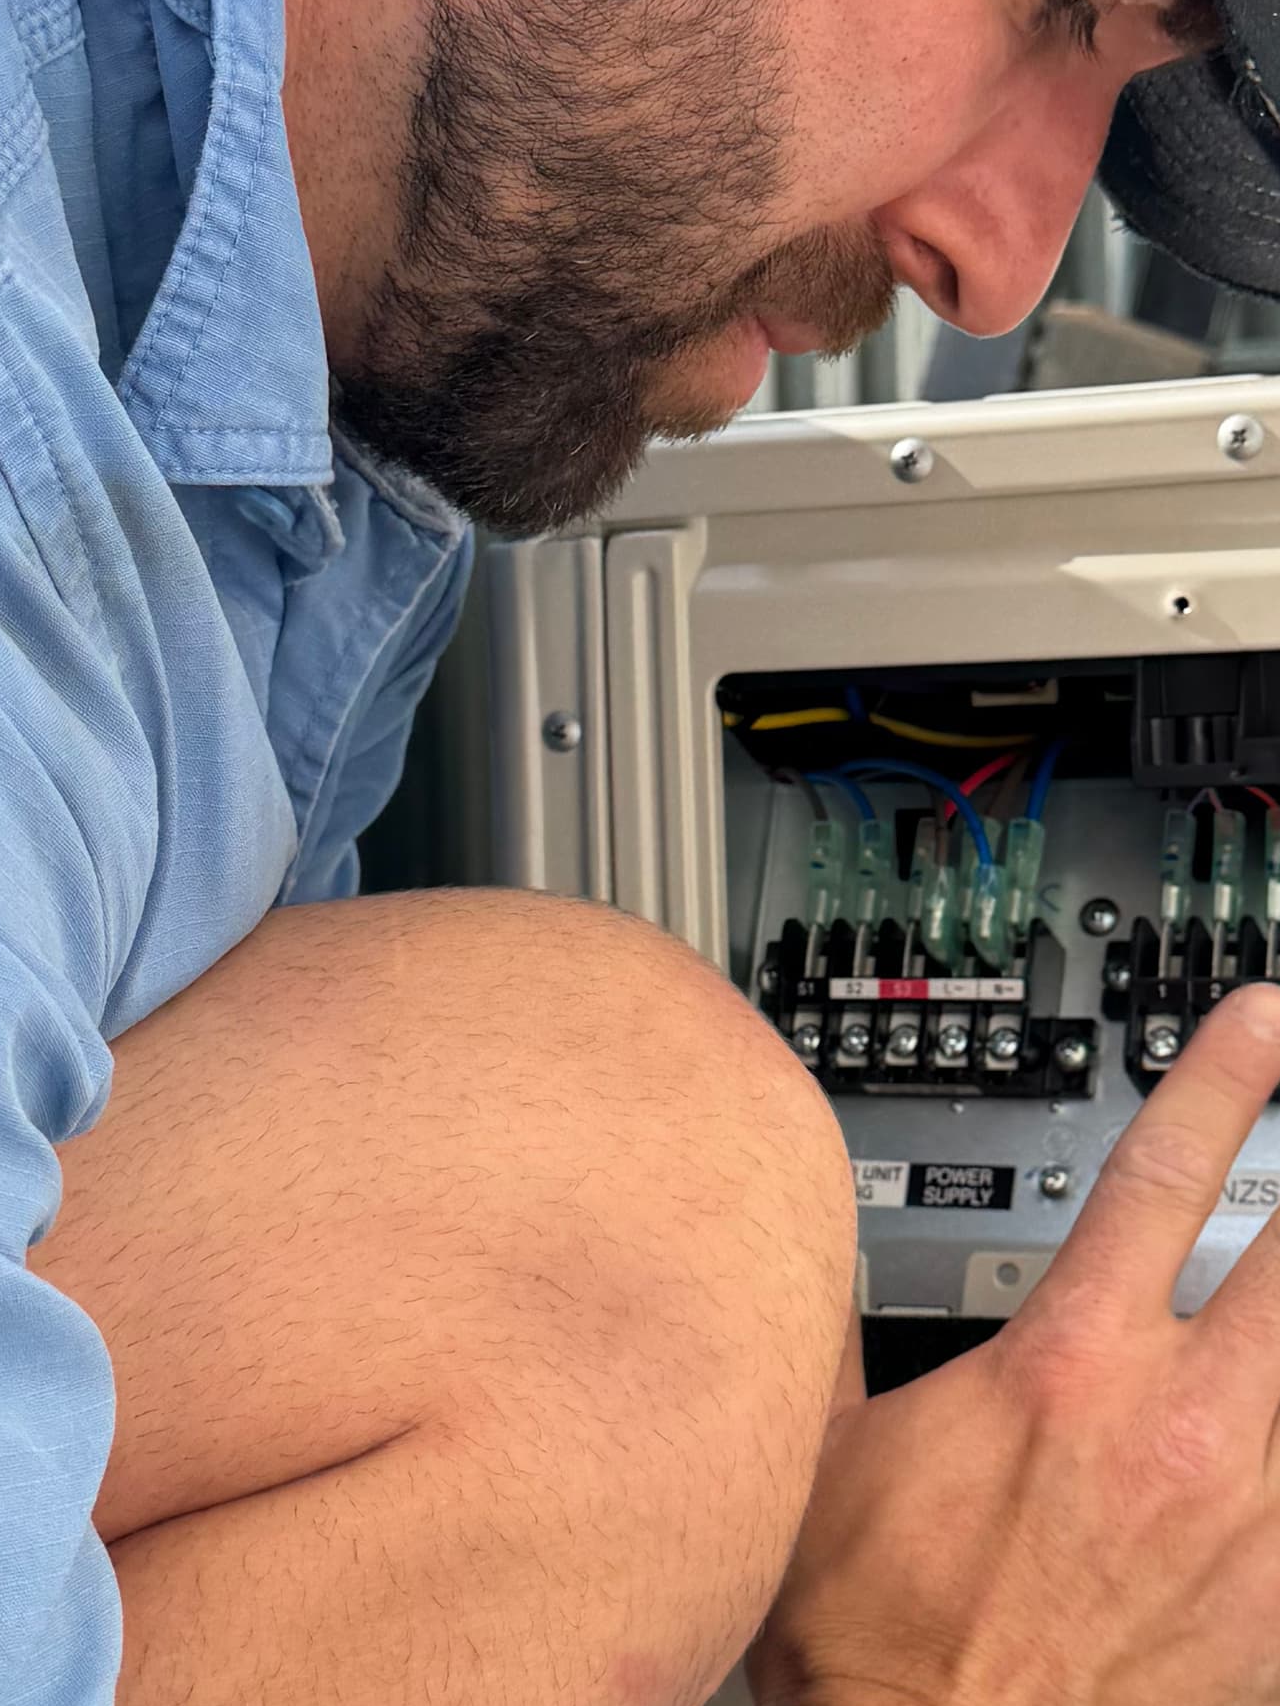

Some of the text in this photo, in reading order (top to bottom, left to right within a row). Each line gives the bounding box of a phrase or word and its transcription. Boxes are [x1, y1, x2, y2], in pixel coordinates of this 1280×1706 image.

[845, 981, 863, 994] S2
[862, 1166, 903, 1181] UNIT
[925, 1166, 994, 1186] POWER
[922, 1186, 994, 1207] SUPPLY
